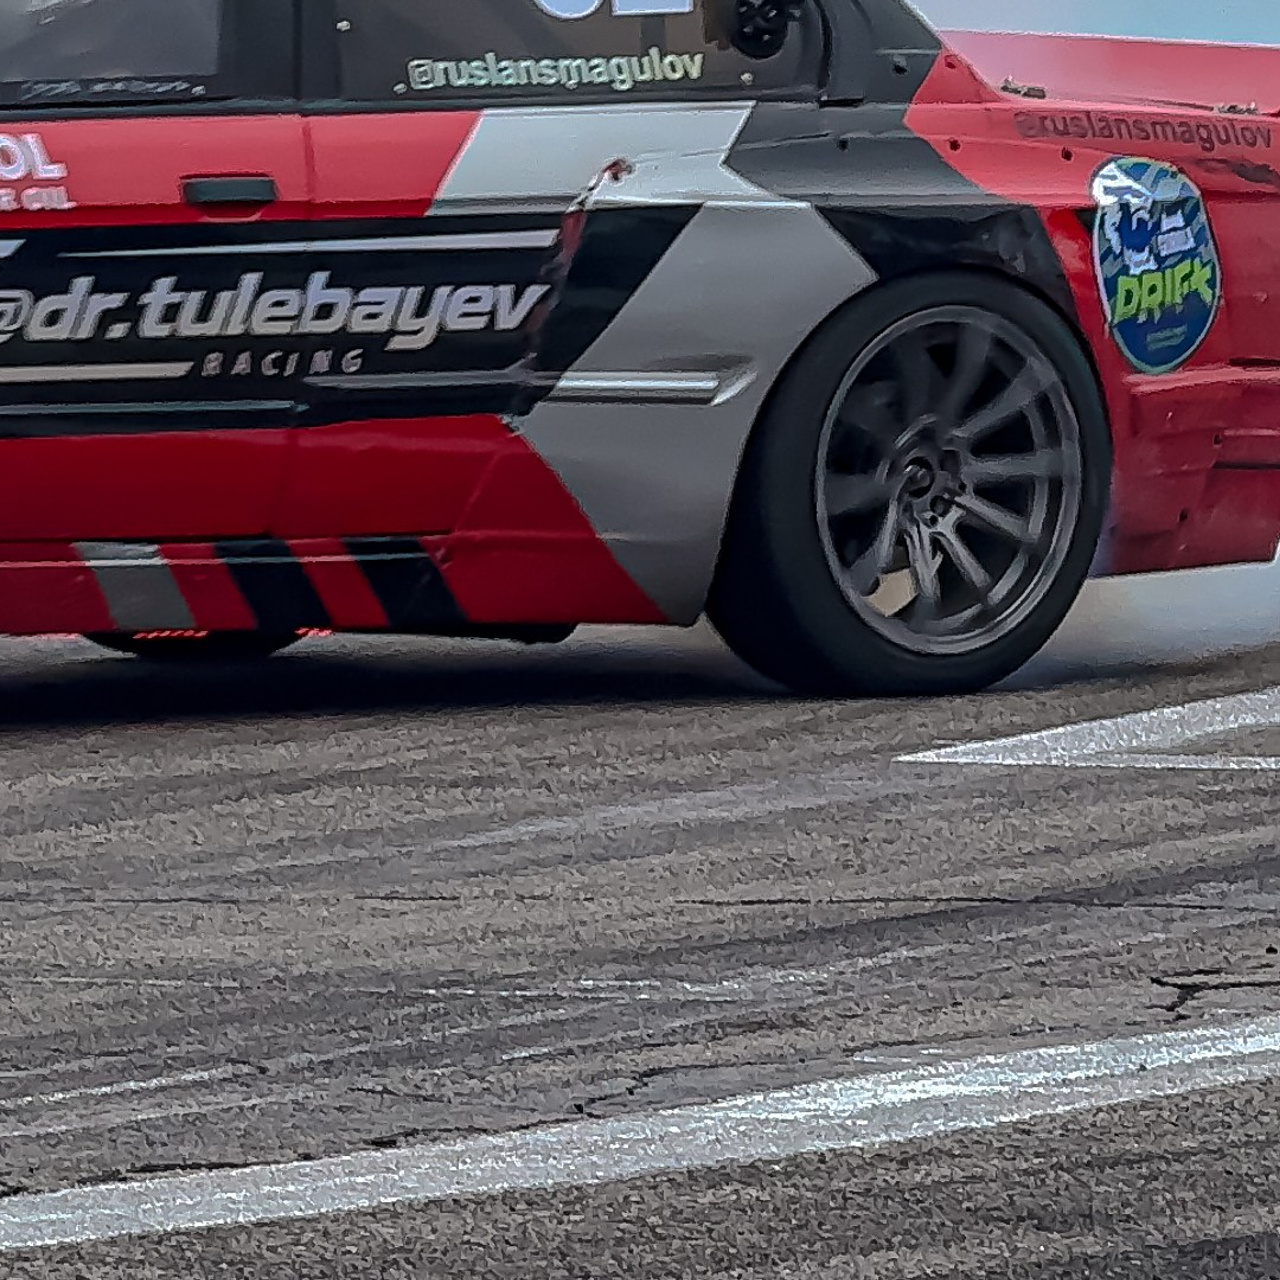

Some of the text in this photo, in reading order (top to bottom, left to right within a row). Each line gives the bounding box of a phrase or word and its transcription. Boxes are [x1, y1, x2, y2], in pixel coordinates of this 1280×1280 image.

[407, 46, 705, 91] @ruslansmagulov
[1014, 111, 1272, 153] @ruslansmagulov
[200, 349, 364, 377] RACING
